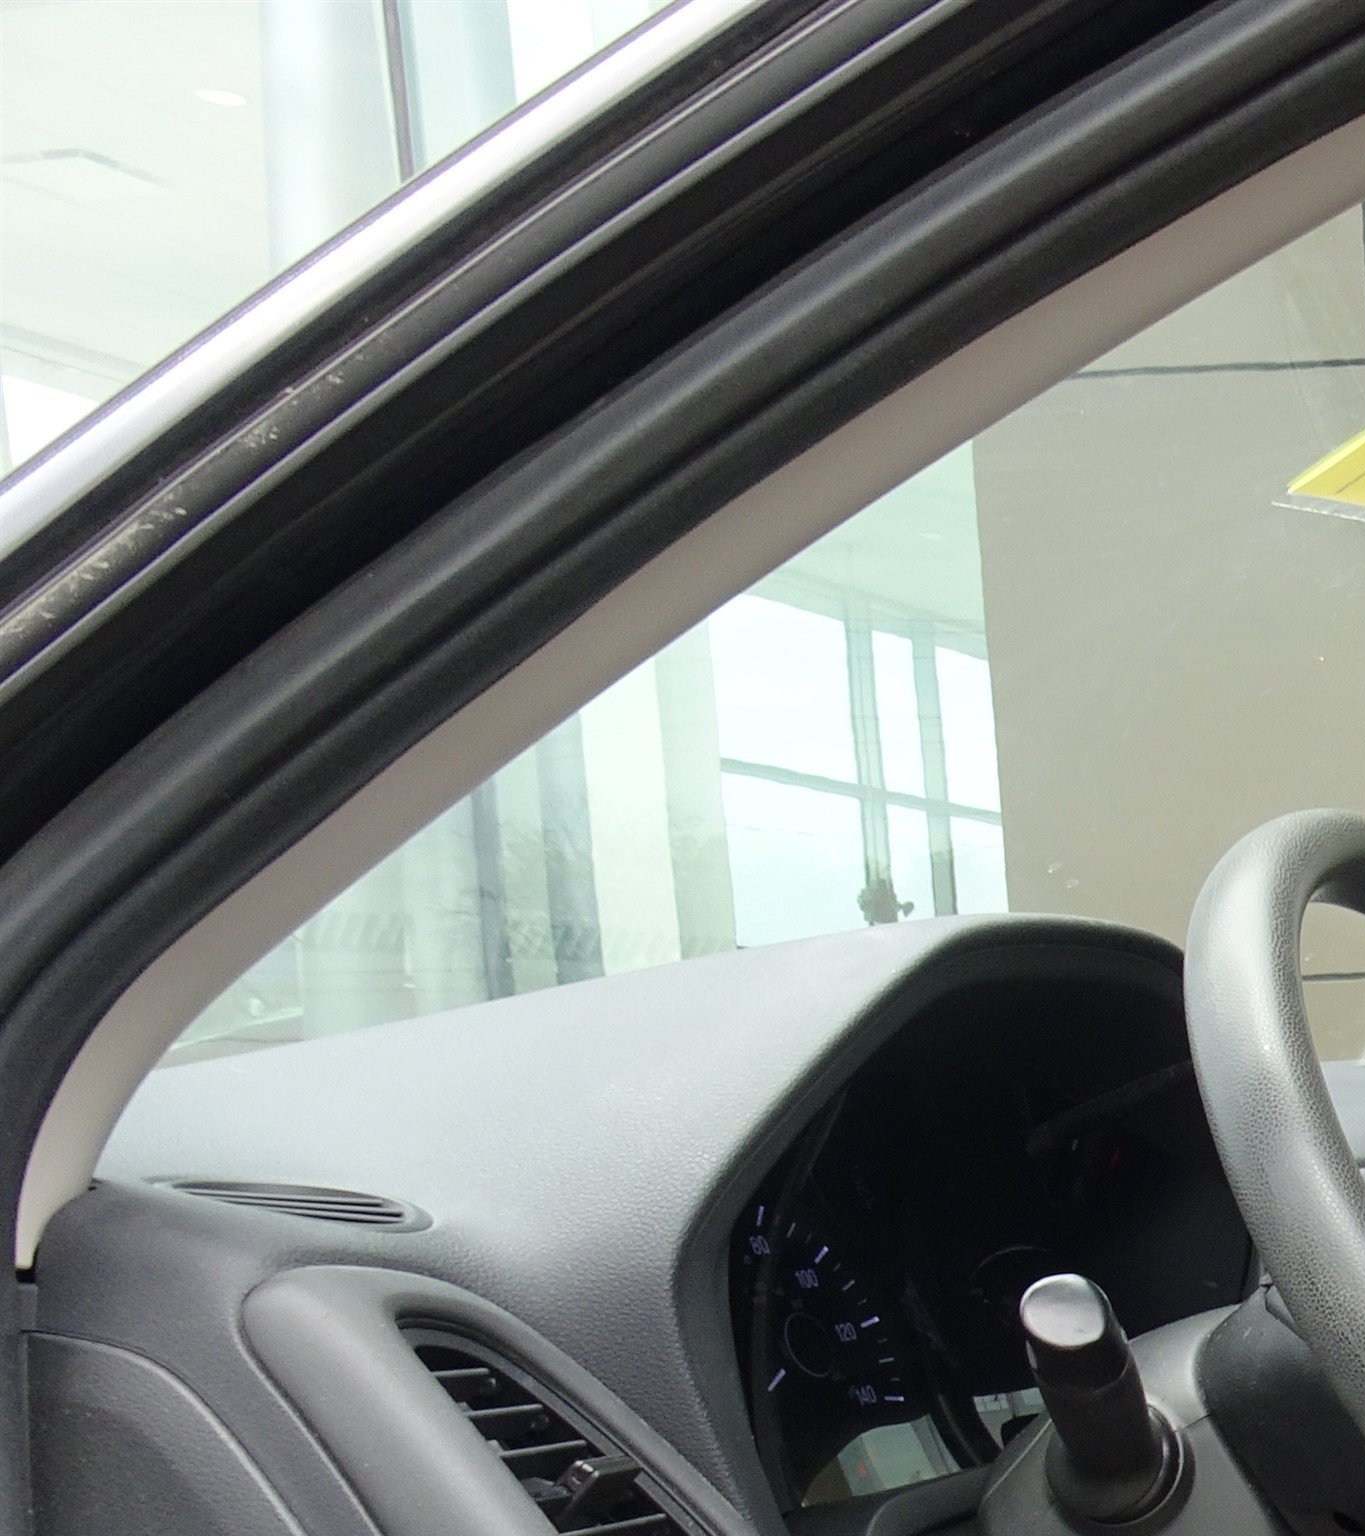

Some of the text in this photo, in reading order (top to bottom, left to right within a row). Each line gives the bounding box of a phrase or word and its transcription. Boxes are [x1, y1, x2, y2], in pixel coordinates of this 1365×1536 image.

[795, 1268, 819, 1289] 100
[835, 1322, 858, 1341] 120
[856, 1386, 877, 1406] 140
